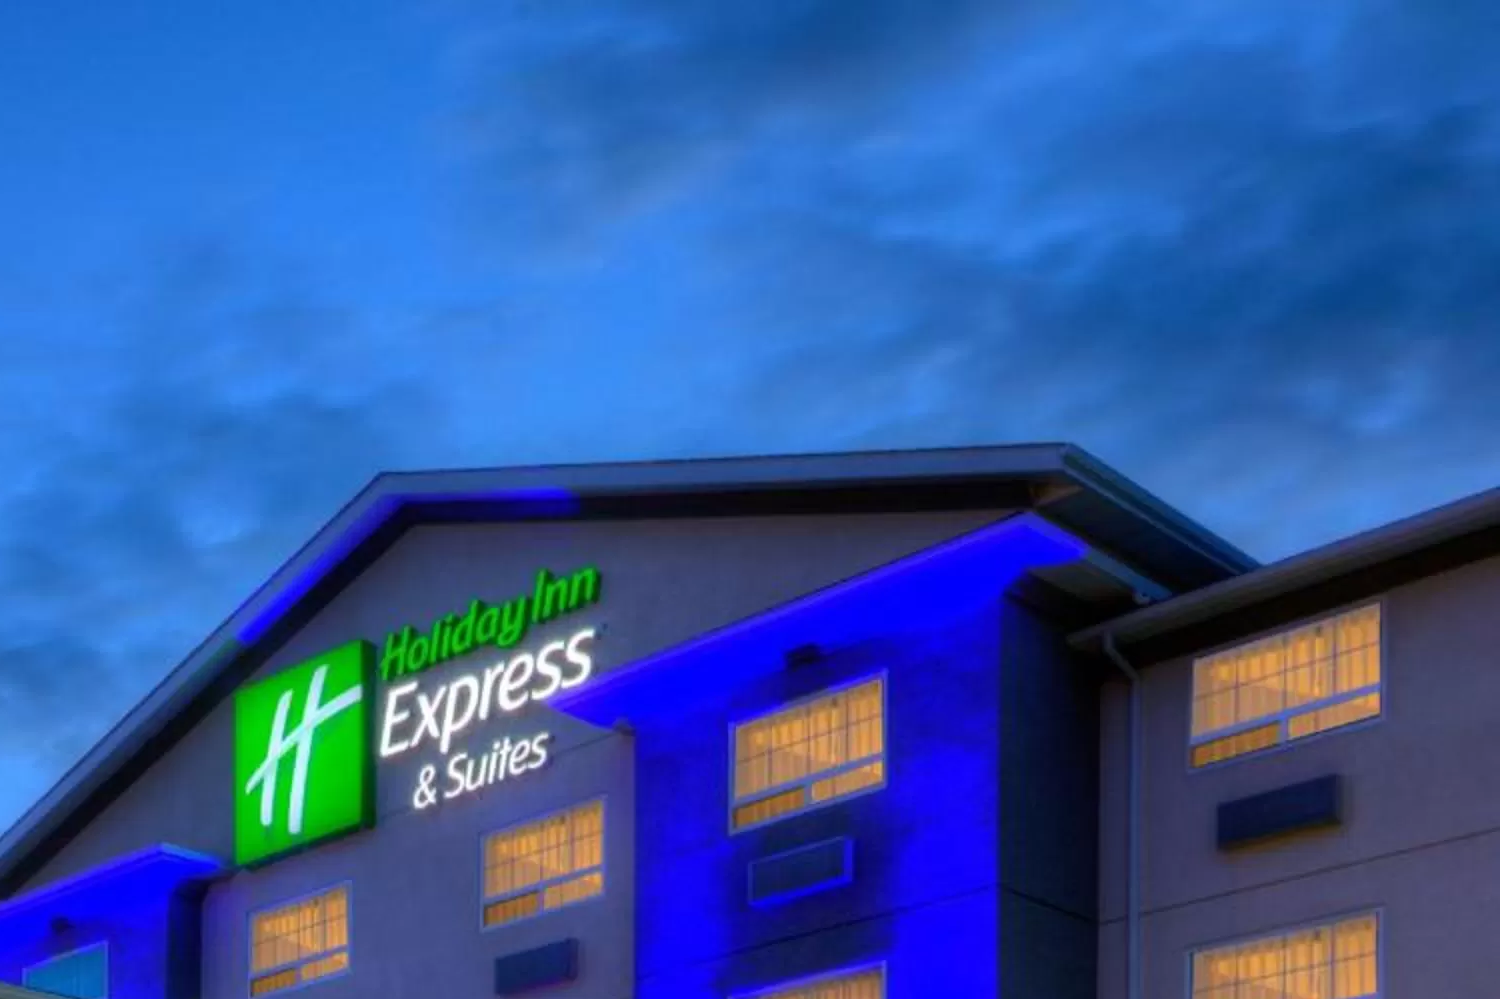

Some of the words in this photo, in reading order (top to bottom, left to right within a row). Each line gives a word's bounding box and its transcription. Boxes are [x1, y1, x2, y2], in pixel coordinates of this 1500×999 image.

[380, 598, 528, 681] Holiday
[533, 567, 600, 624] Inn
[379, 627, 595, 758] Express
[412, 764, 437, 810] &
[444, 732, 550, 799] Suites
